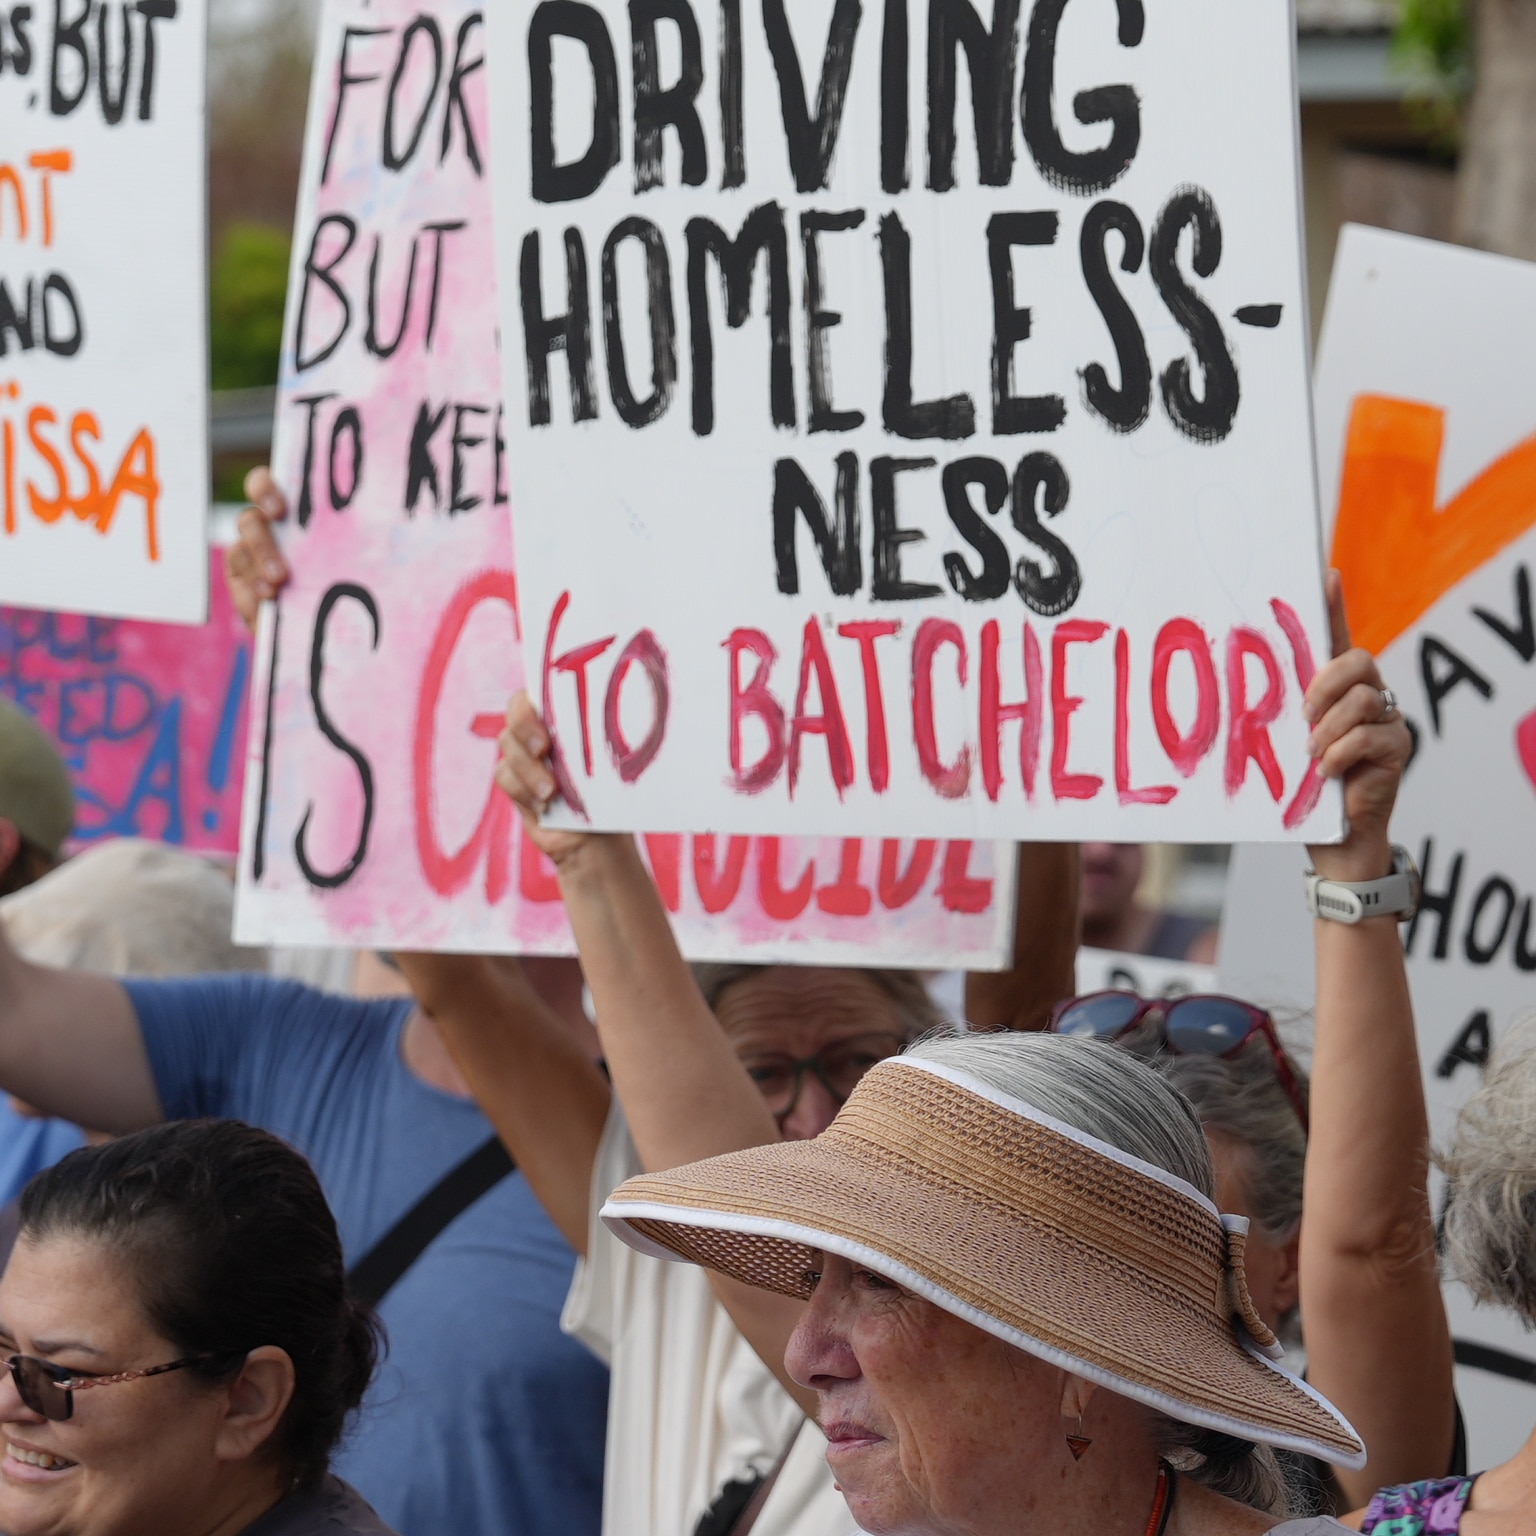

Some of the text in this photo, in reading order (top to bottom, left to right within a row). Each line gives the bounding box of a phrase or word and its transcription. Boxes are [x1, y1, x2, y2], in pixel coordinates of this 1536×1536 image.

[320, 13, 484, 188] FOR
[296, 213, 467, 373] BUT
[520, 183, 1284, 445] HOMELESS-
[292, 389, 363, 530] TO
[773, 450, 1083, 616] NESS
[254, 581, 381, 890] IS
[542, 589, 671, 825] (TO
[721, 597, 1326, 830] BATCHELOR)
